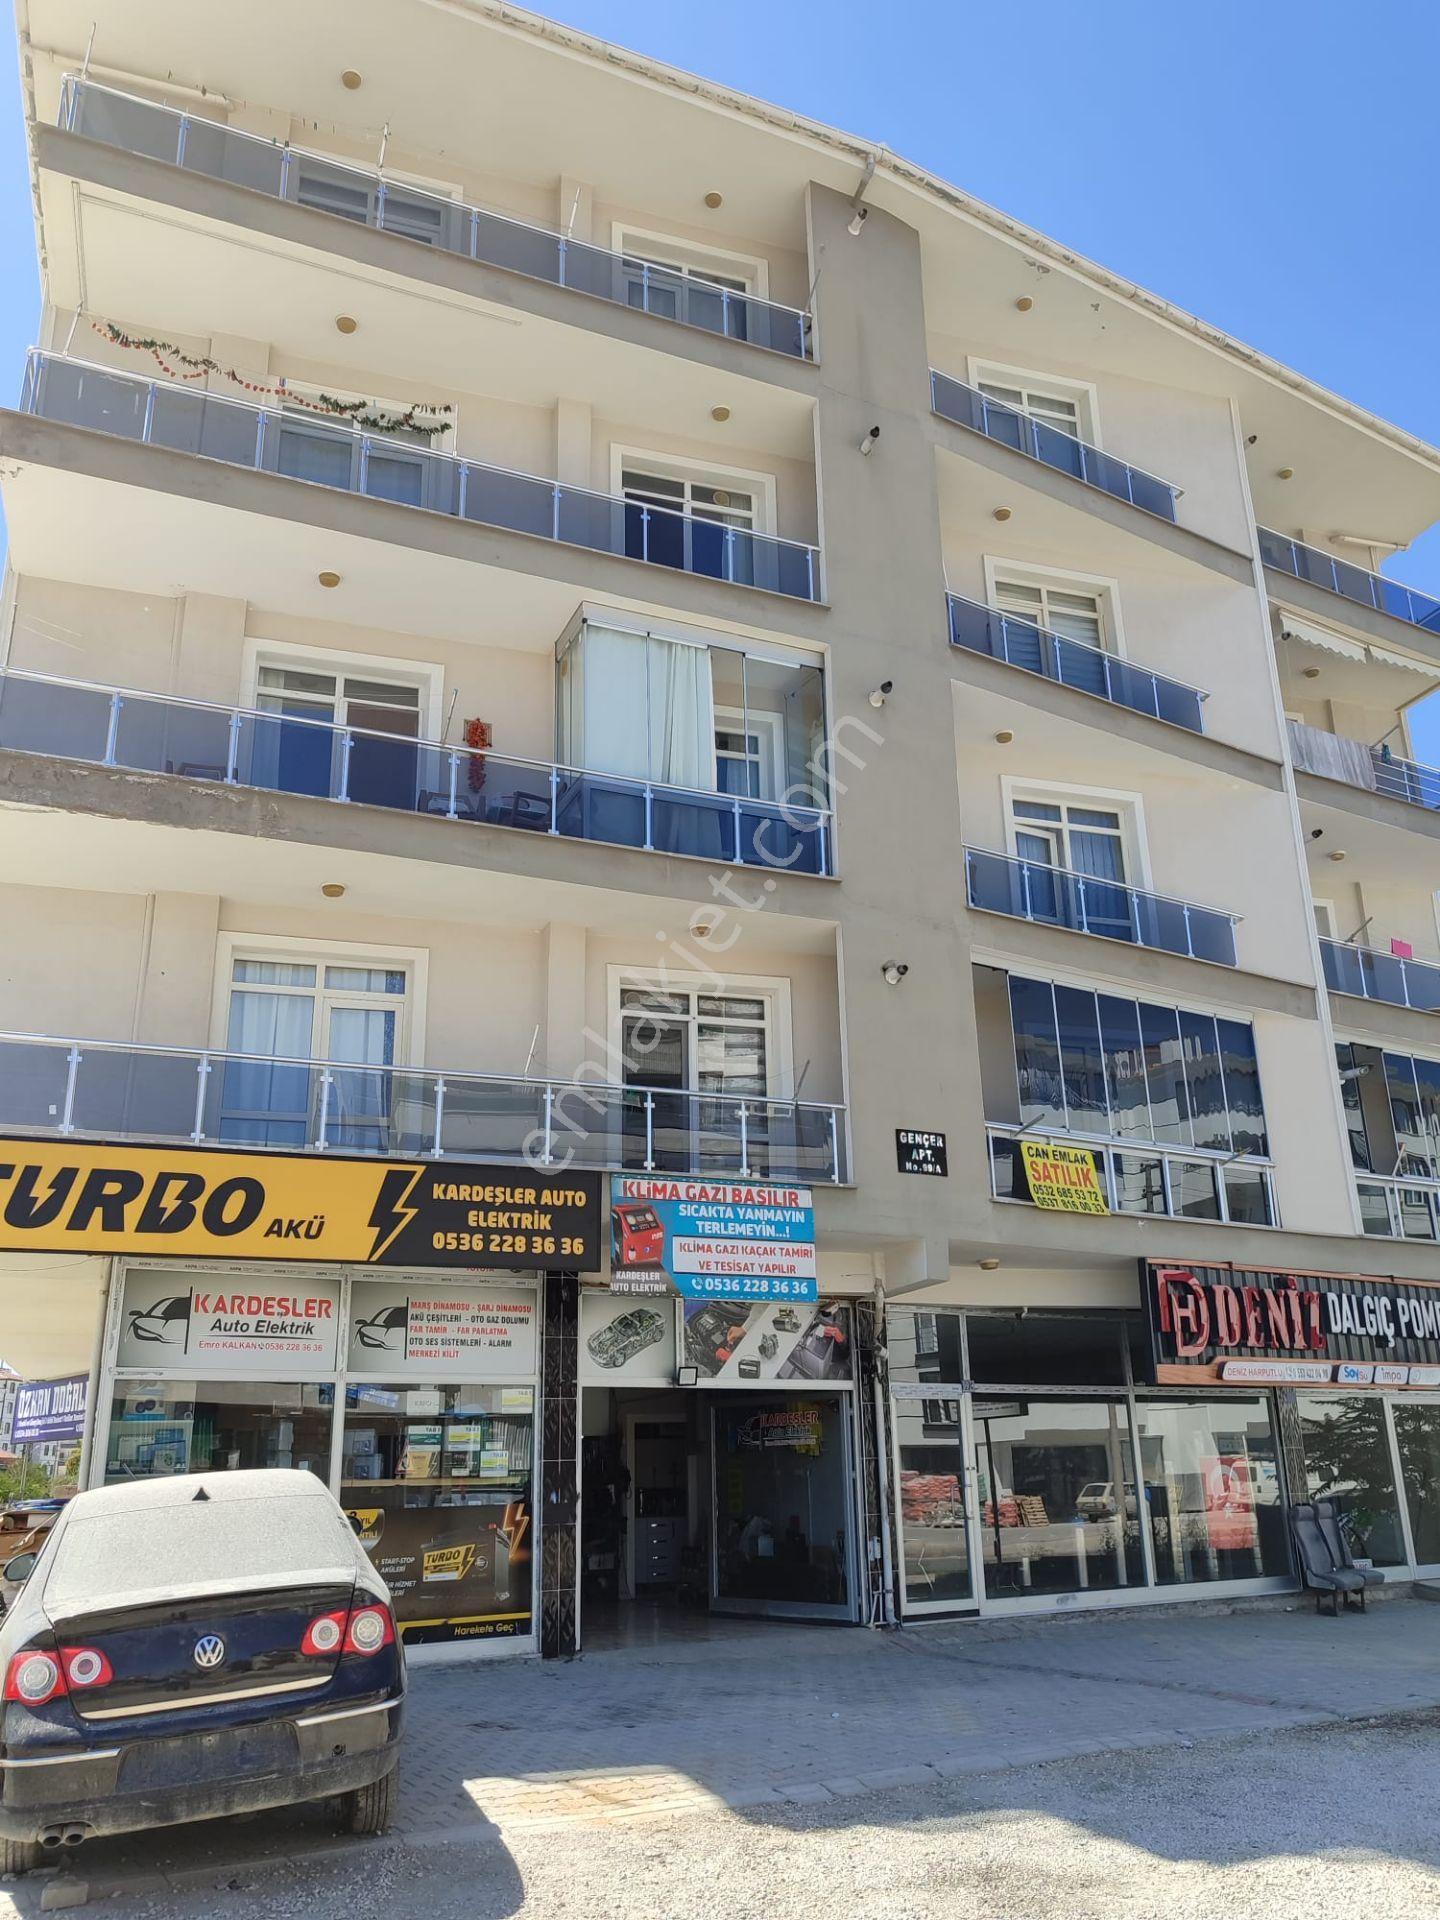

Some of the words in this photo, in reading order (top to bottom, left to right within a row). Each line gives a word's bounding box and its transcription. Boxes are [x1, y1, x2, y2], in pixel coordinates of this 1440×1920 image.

[900, 1132, 943, 1150] GENÇER
[912, 1149, 934, 1162] APT.
[1027, 1145, 1050, 1160] CAN
[1053, 1150, 1088, 1166] EMLAK
[1029, 1161, 1096, 1188] SATILIK
[432, 1183, 536, 1207] KARDEŞLER
[540, 1189, 587, 1208] AUTO
[685, 1184, 728, 1204] GAZI
[731, 1187, 800, 1208] BASILIR
[1033, 1184, 1056, 1196] 0532
[1056, 1187, 1074, 1199] 685
[1074, 1189, 1087, 1201] 53
[1087, 1191, 1100, 1202] 72
[1037, 1196, 1060, 1208] 0537
[468, 1209, 552, 1230] ELEKTRİK
[679, 1204, 734, 1220] SICAKTA
[737, 1208, 805, 1224] YANMAYIN
[264, 1215, 326, 1240] AKÜ
[432, 1231, 484, 1252] 0536
[489, 1234, 526, 1253] 228
[531, 1236, 556, 1254] 36
[560, 1237, 584, 1256] 36
[679, 1240, 714, 1255] KLİMA
[715, 1244, 739, 1256] GAZI
[741, 1245, 777, 1259] KAÇAK
[698, 1260, 712, 1271] VE
[715, 1259, 756, 1273] TESİSAT
[757, 1263, 797, 1275] YAPILIR
[615, 1271, 660, 1282] KARDEŞLER
[610, 1282, 630, 1292] AUTO
[631, 1282, 668, 1293] ELEKTRİK
[704, 1278, 740, 1292] 0536
[743, 1279, 769, 1293] 228
[772, 1281, 790, 1294] 36
[792, 1281, 809, 1295] 36
[410, 1301, 432, 1311] MARŞ
[433, 1301, 470, 1312] DİNAMOSU
[477, 1304, 494, 1314] ŞARJ
[496, 1303, 532, 1313] DİNAMOSU
[1211, 1275, 1328, 1350] DENİZ
[210, 1318, 250, 1334] Auto
[254, 1320, 316, 1336] Elektrik
[410, 1313, 424, 1322] AKÜ
[427, 1314, 462, 1324] ÇEŞİTLERİ
[470, 1315, 484, 1324] OTO
[486, 1316, 500, 1324] GAZ
[501, 1316, 529, 1325] DOLUMU
[1327, 1292, 1396, 1348] DALGIÇ
[409, 1325, 424, 1334] FAR
[457, 1326, 470, 1335] FAR
[472, 1327, 508, 1336] PARLATMA
[199, 1340, 220, 1350] Emre
[222, 1341, 257, 1350] KALKAN
[265, 1343, 285, 1351] 0536
[285, 1343, 302, 1352] 228
[302, 1343, 312, 1352] 36
[313, 1344, 323, 1352] 36
[409, 1337, 423, 1346] OTO
[425, 1338, 439, 1346] SES
[440, 1337, 481, 1347] SİSTEMLERİ
[488, 1339, 512, 1348] ALARM
[409, 1349, 440, 1358] MERKEZİ
[380, 1556, 416, 1565] START-STOP
[426, 1550, 461, 1564] TURBO
[454, 1625, 494, 1636] Harekete
[495, 1623, 514, 1634] Geç
